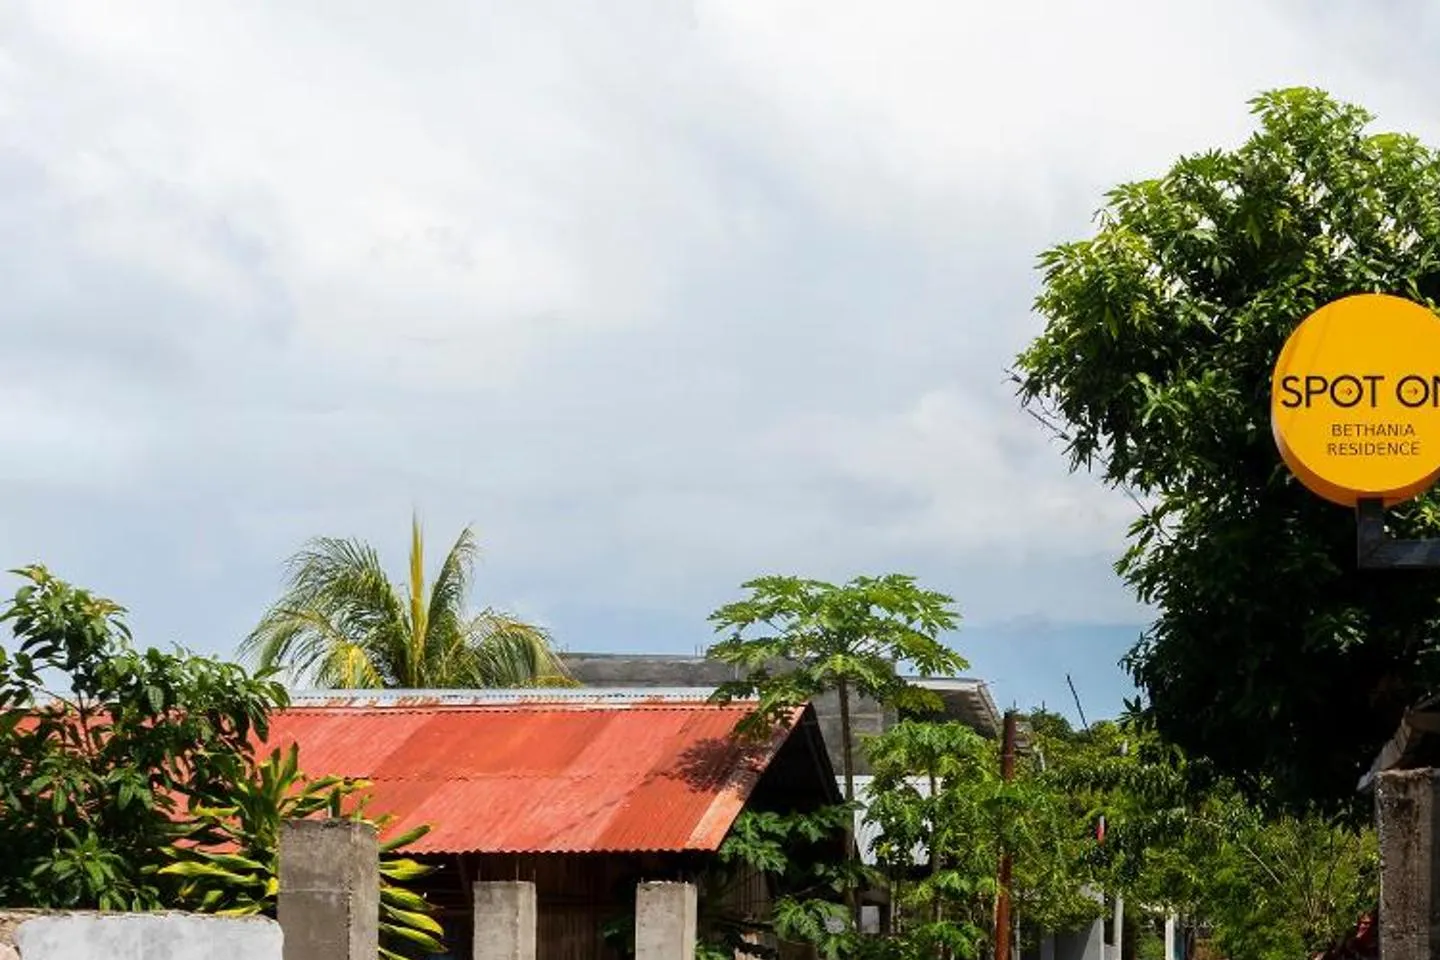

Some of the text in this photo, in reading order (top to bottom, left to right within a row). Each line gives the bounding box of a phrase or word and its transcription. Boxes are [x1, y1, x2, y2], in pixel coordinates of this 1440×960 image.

[1281, 374, 1385, 408] SPOT
[1331, 423, 1416, 437] BETHANIA
[1327, 442, 1421, 456] RESIDENCE
